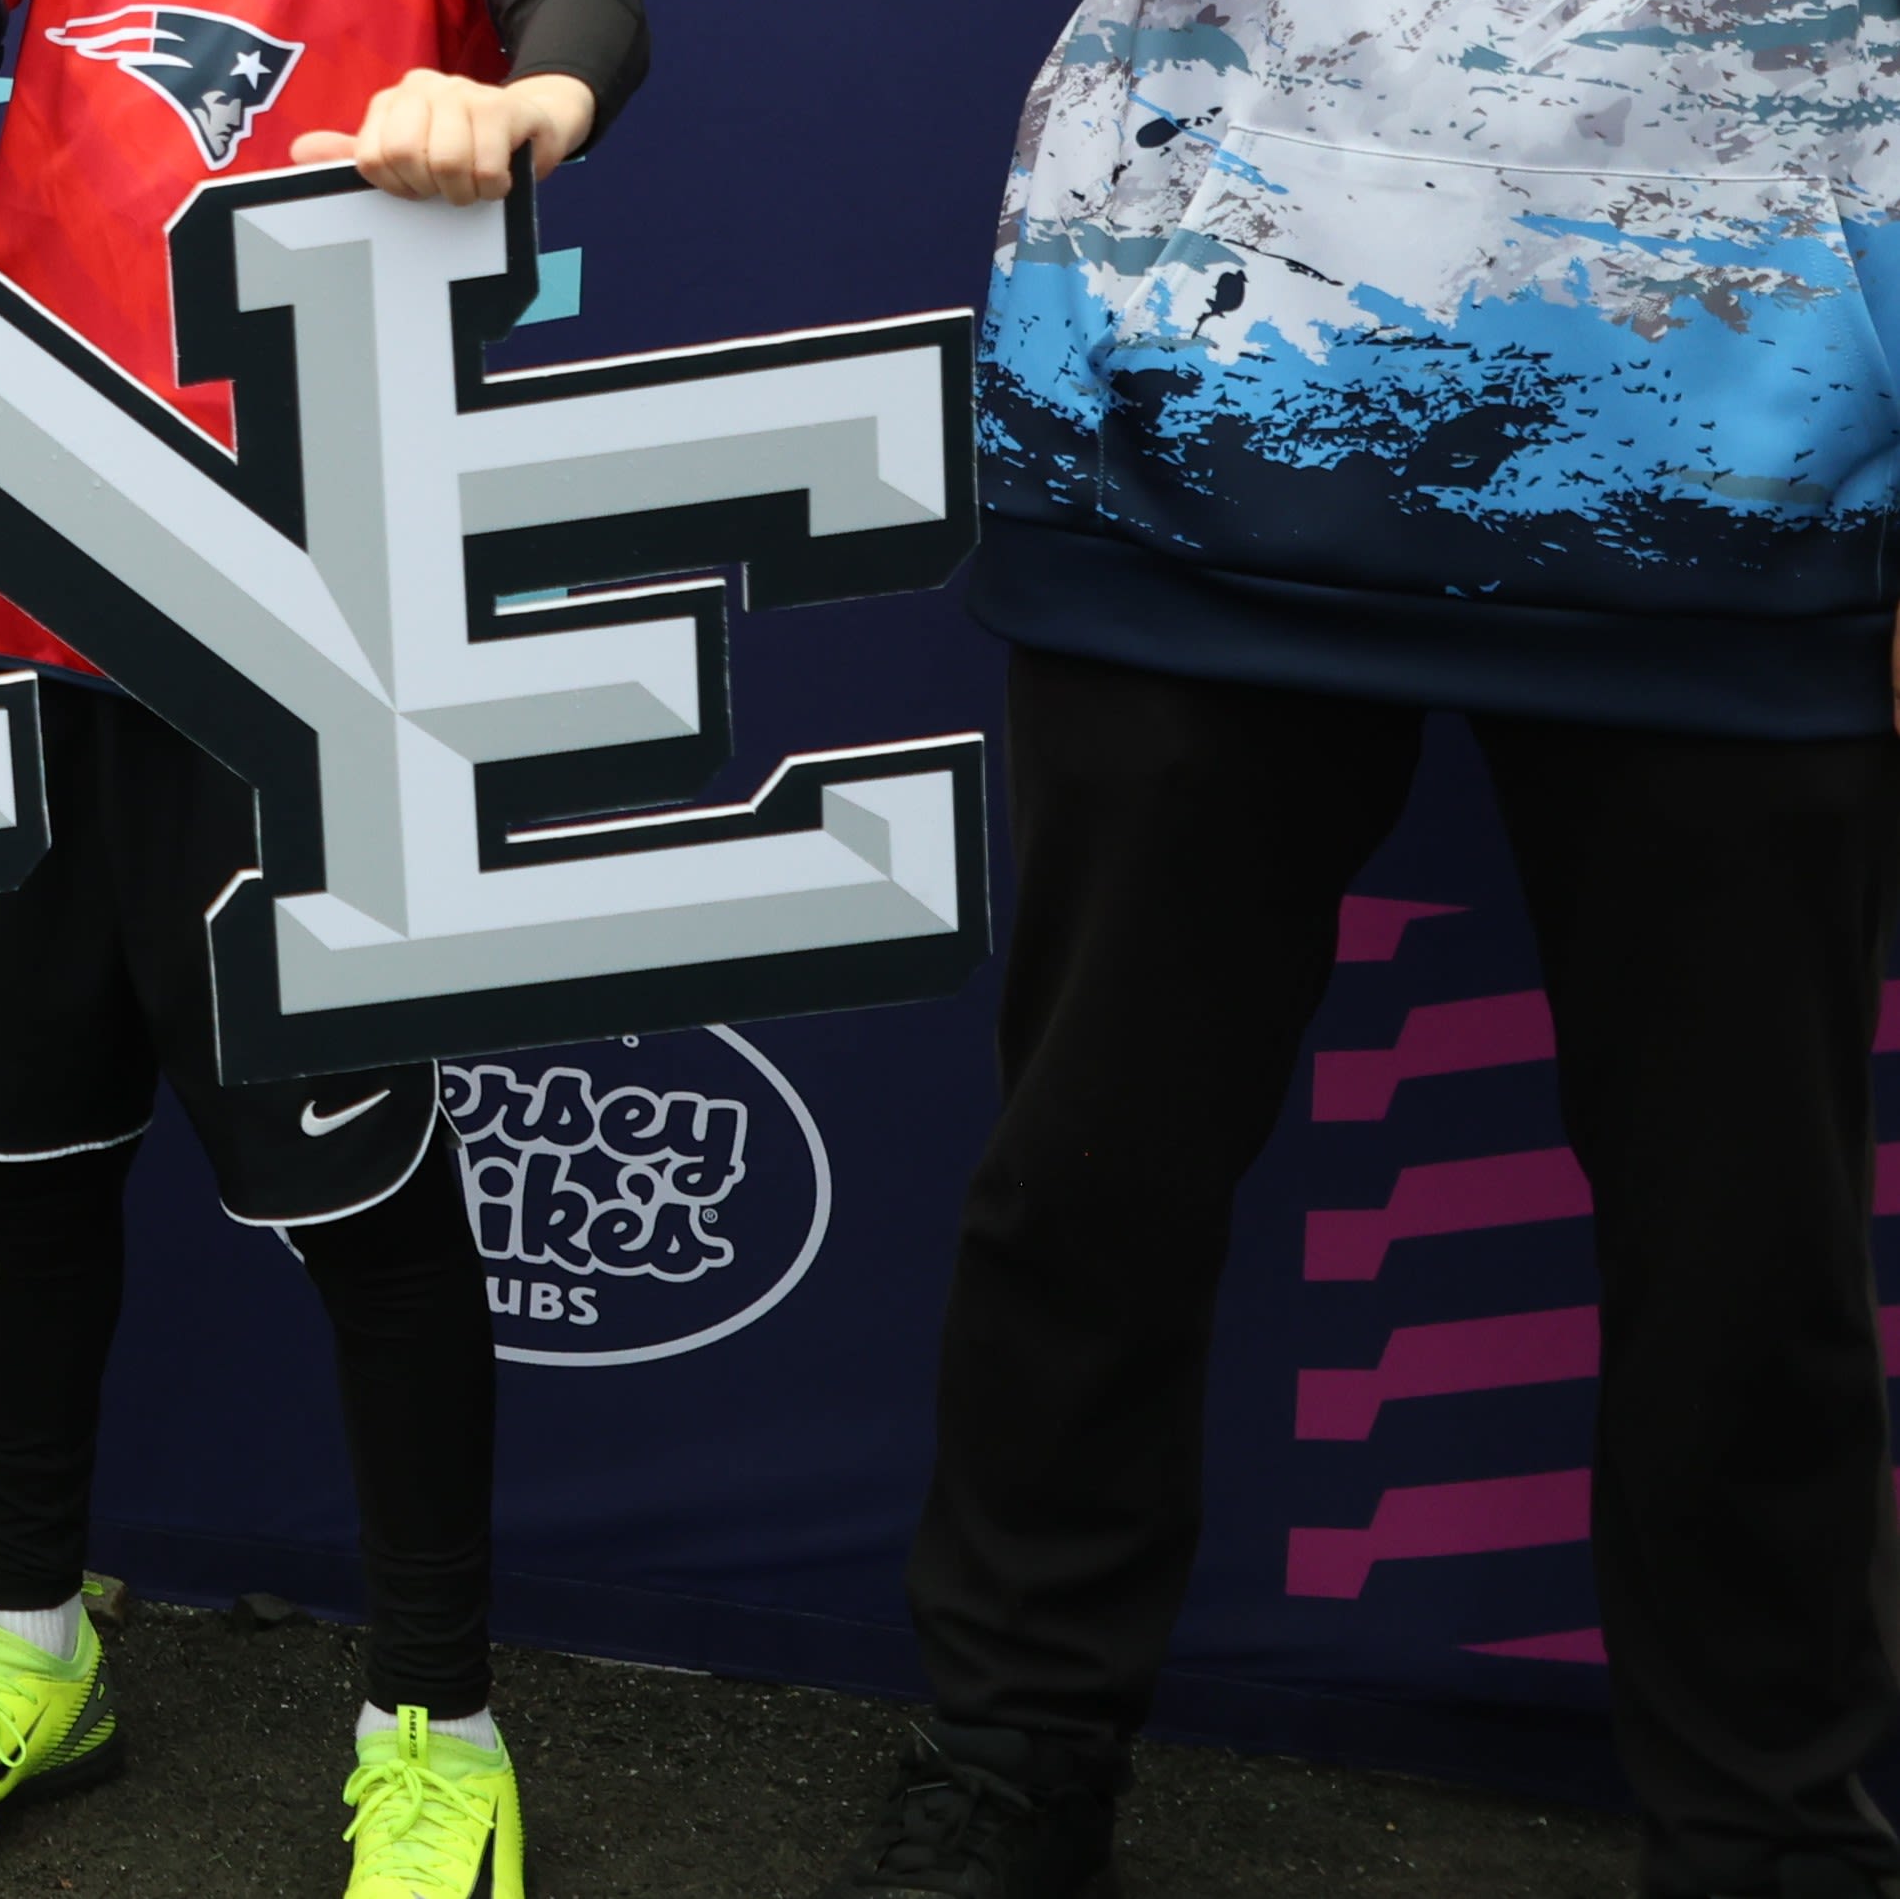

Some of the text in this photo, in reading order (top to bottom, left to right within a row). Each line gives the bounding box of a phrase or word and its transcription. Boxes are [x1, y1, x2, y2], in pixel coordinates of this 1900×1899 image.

[439, 1064, 749, 1206] ersey
[463, 1150, 735, 1284] ike's
[485, 1275, 600, 1327] UBS
